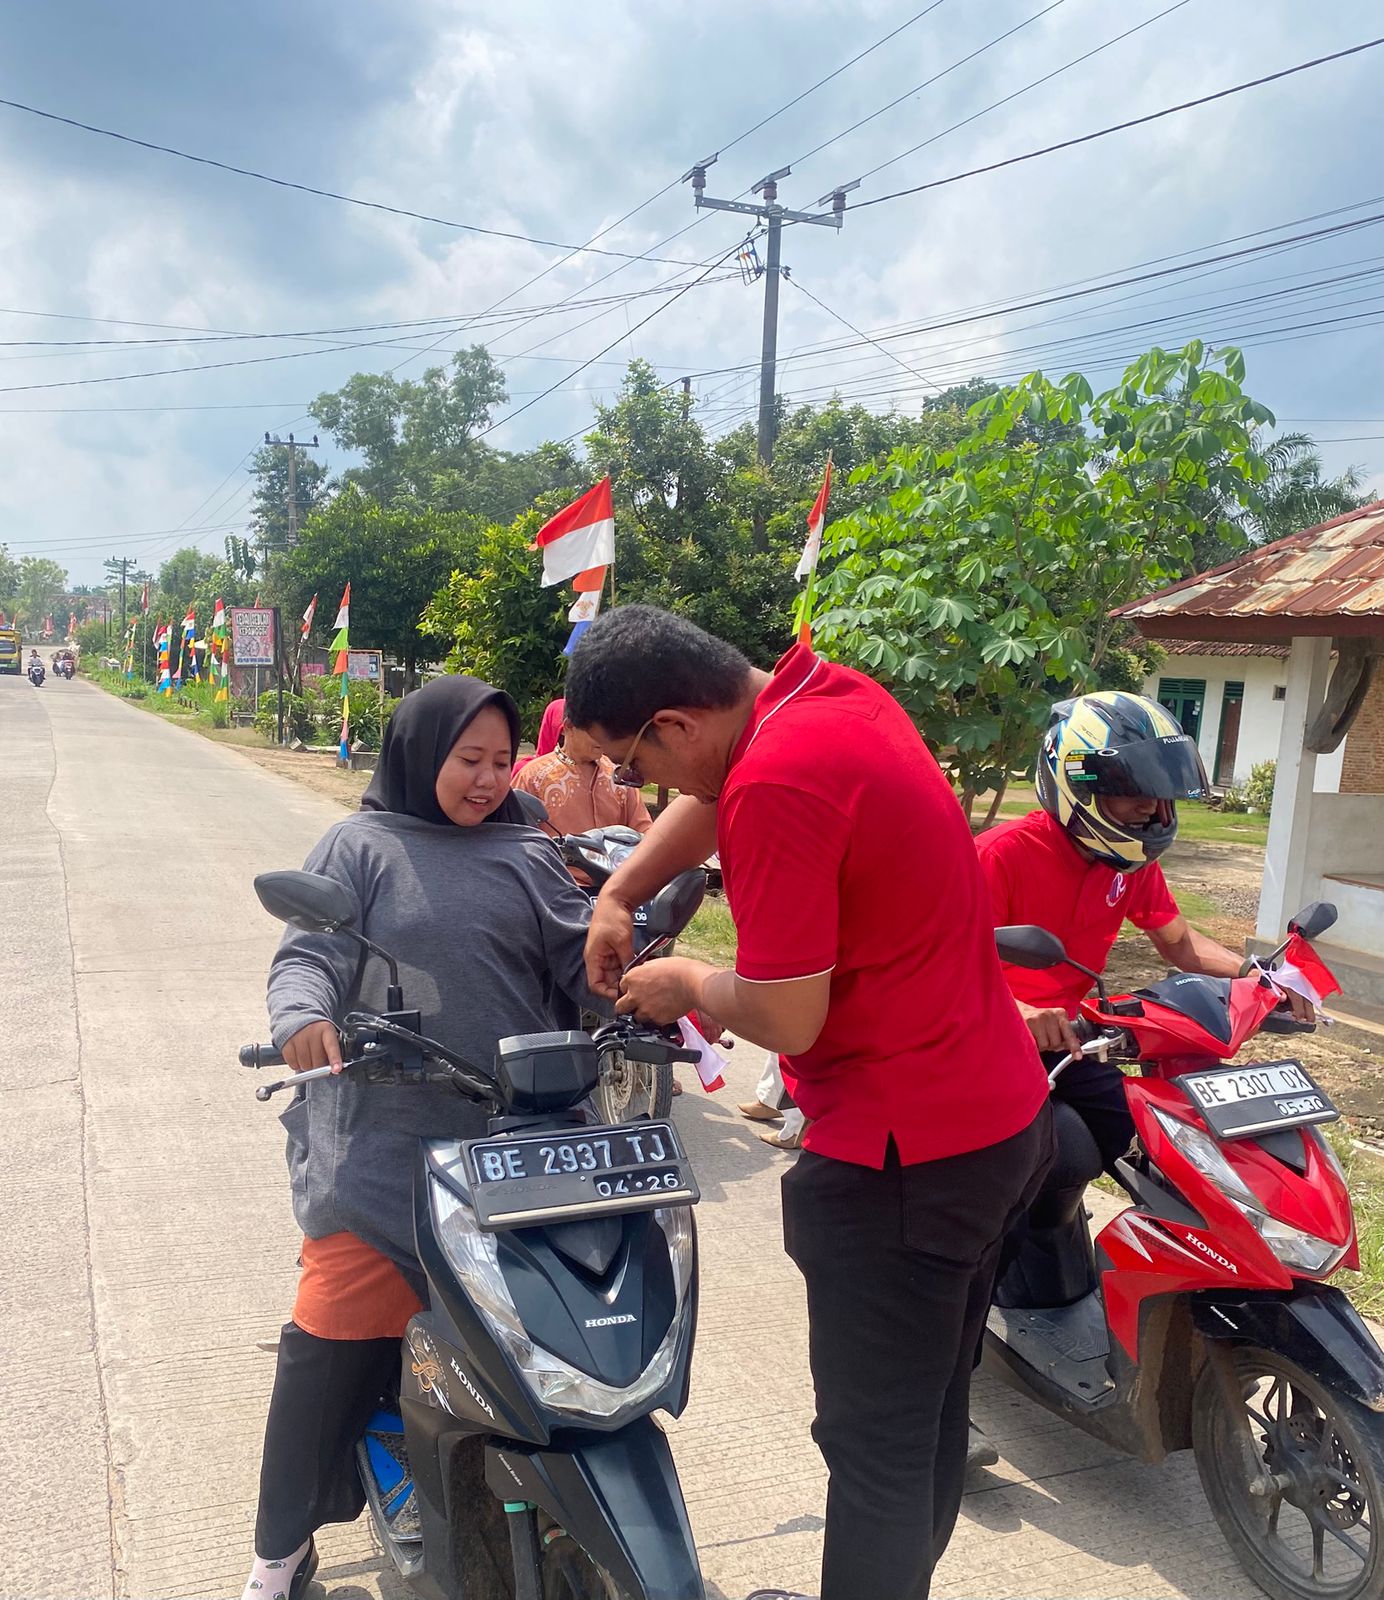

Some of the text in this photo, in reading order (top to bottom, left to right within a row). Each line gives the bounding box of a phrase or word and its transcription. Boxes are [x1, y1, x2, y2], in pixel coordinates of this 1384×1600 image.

[1194, 1081, 1226, 1104] BE
[1228, 1072, 1277, 1099] 2307
[482, 1133, 666, 1181] BE 2937 TJ
[1185, 1232, 1239, 1275] HONDA
[585, 1314, 637, 1328] HONDA
[450, 1357, 496, 1421] HONDA
